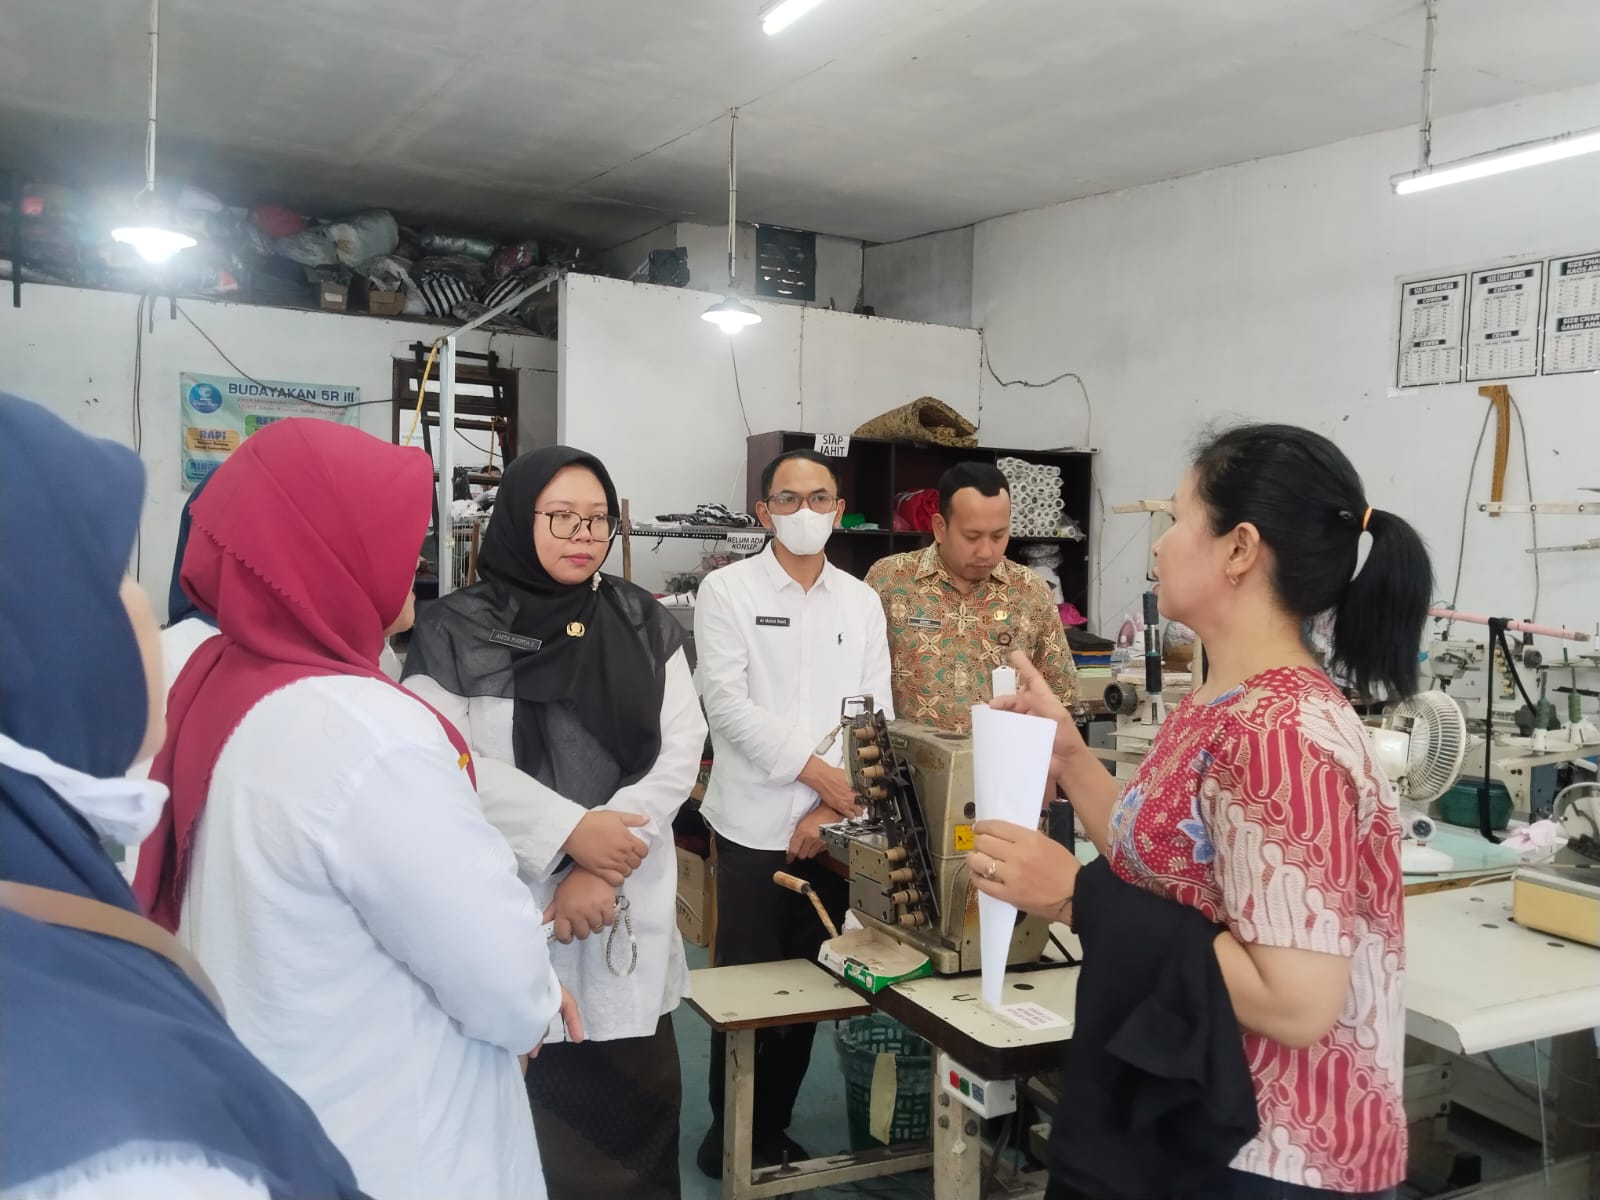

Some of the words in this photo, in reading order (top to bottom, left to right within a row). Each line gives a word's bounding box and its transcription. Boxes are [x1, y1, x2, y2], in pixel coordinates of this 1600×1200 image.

[1567, 260, 1583, 269] SIZE
[1567, 267, 1586, 275] KAOS
[1563, 316, 1579, 325] SIZE
[1580, 313, 1600, 322] CHAR
[1585, 320, 1600, 329] ANA
[228, 383, 316, 400] BUDAYAKAN
[321, 390, 340, 402] 5R
[823, 434, 844, 445] SIAP
[727, 536, 750, 544] BELUM
[750, 537, 764, 545] ADA
